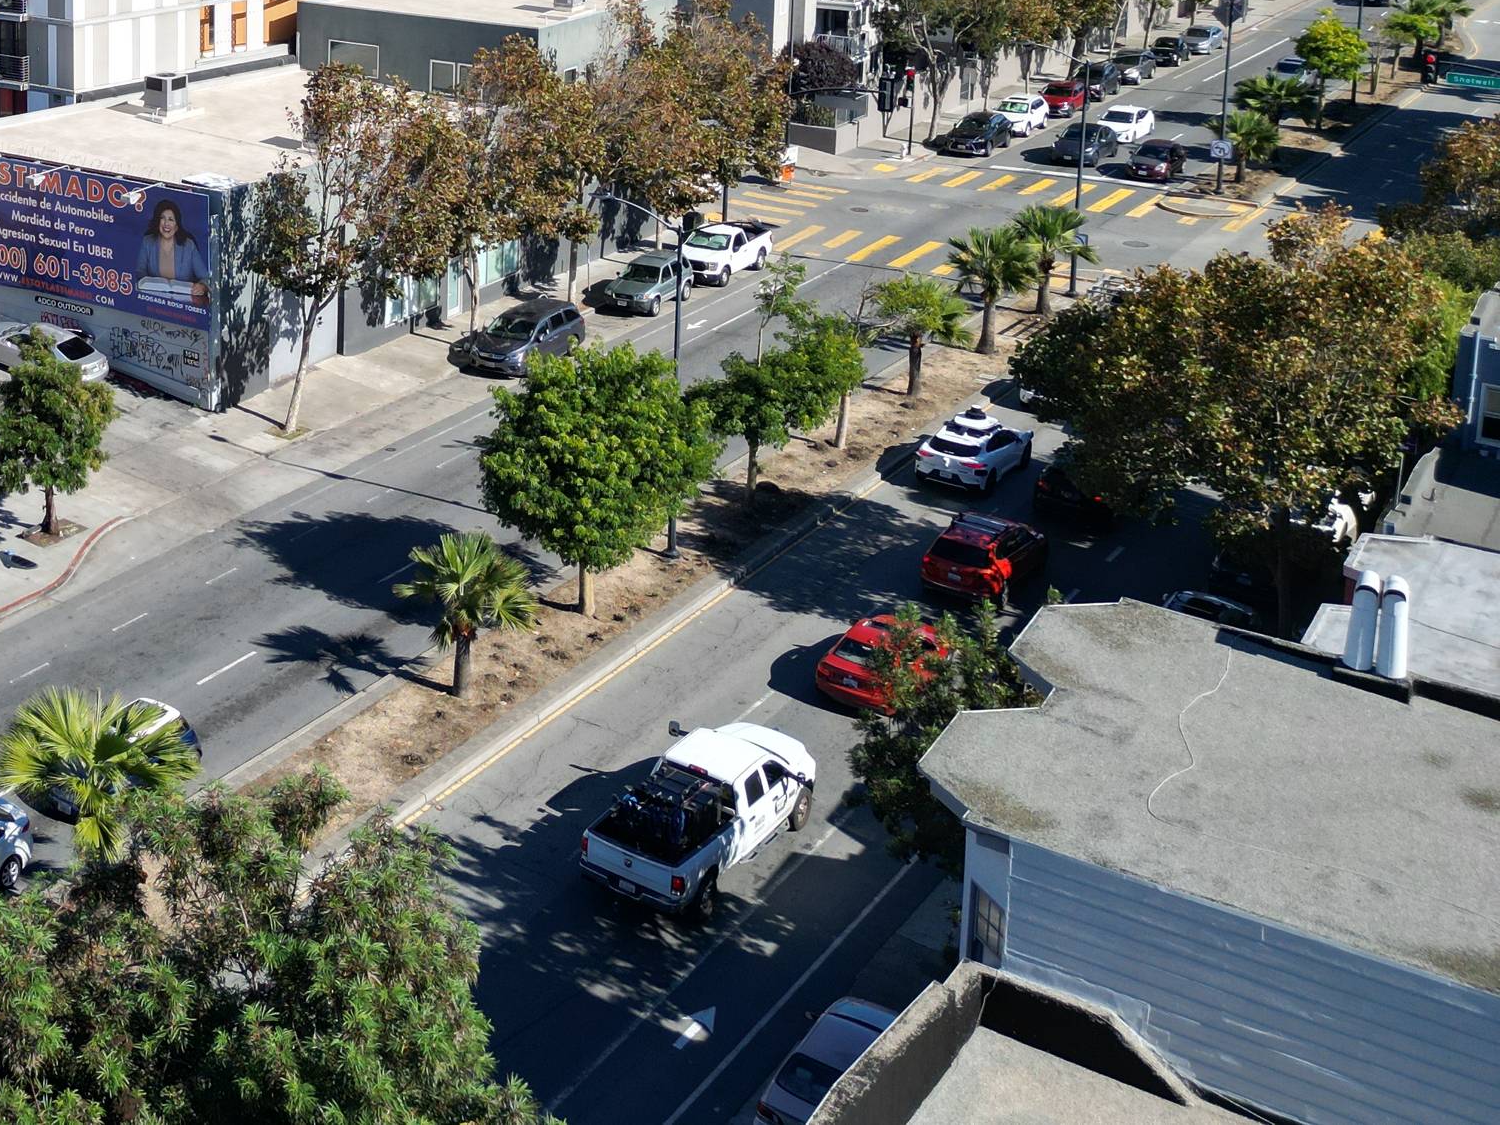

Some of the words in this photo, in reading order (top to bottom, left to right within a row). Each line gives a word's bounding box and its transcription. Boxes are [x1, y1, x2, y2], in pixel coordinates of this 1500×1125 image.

[1453, 75, 1495, 86] Shotwell
[11, 209, 51, 228] Mordida
[53, 218, 66, 231] de
[68, 221, 95, 237] Perro
[39, 197, 52, 210] de
[54, 200, 115, 223] Automobiles
[38, 233, 70, 251] Sexual
[73, 240, 85, 254] En
[87, 244, 114, 260] UBER
[33, 252, 133, 296] 601-3385
[37, 297, 57, 307] ADCO
[57, 301, 92, 315] OUTDOOR
